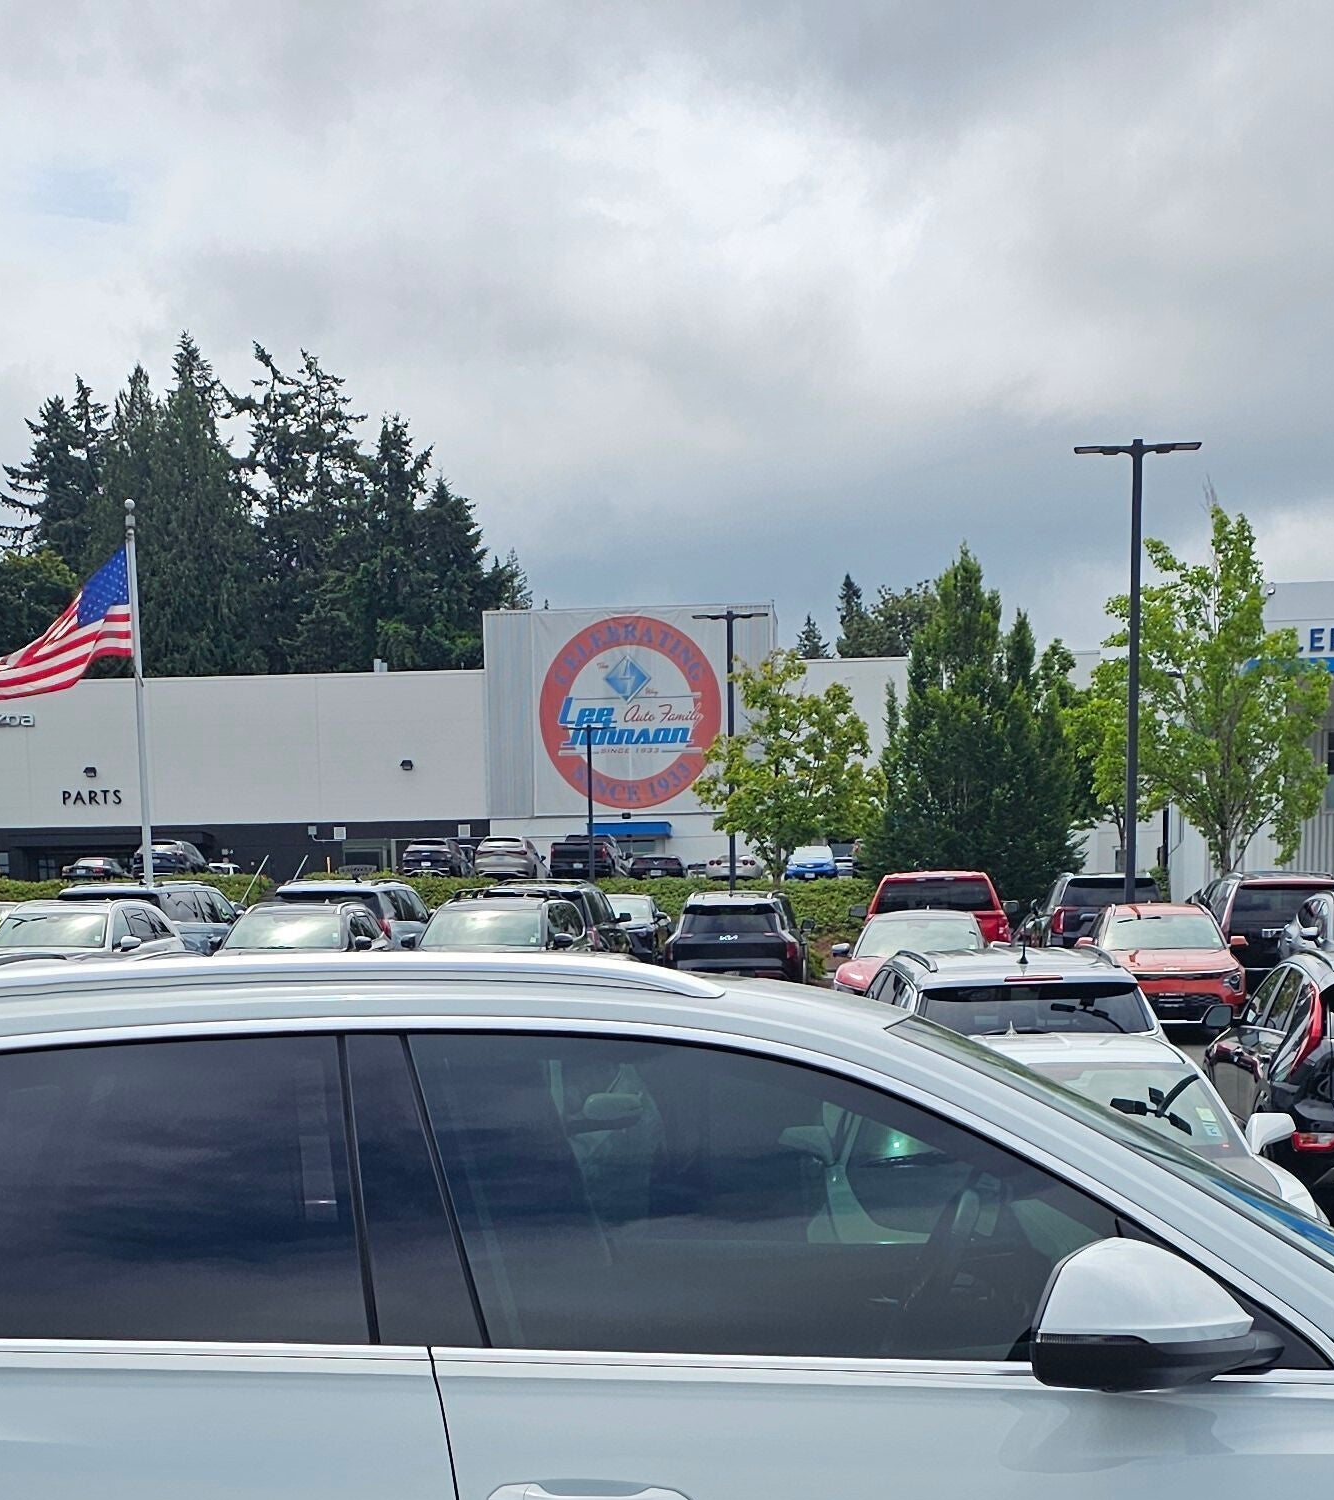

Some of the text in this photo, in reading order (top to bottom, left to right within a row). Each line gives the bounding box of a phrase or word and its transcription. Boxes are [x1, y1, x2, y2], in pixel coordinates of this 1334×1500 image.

[558, 696, 704, 729] Lee Auto Family
[62, 789, 123, 806] PARTS
